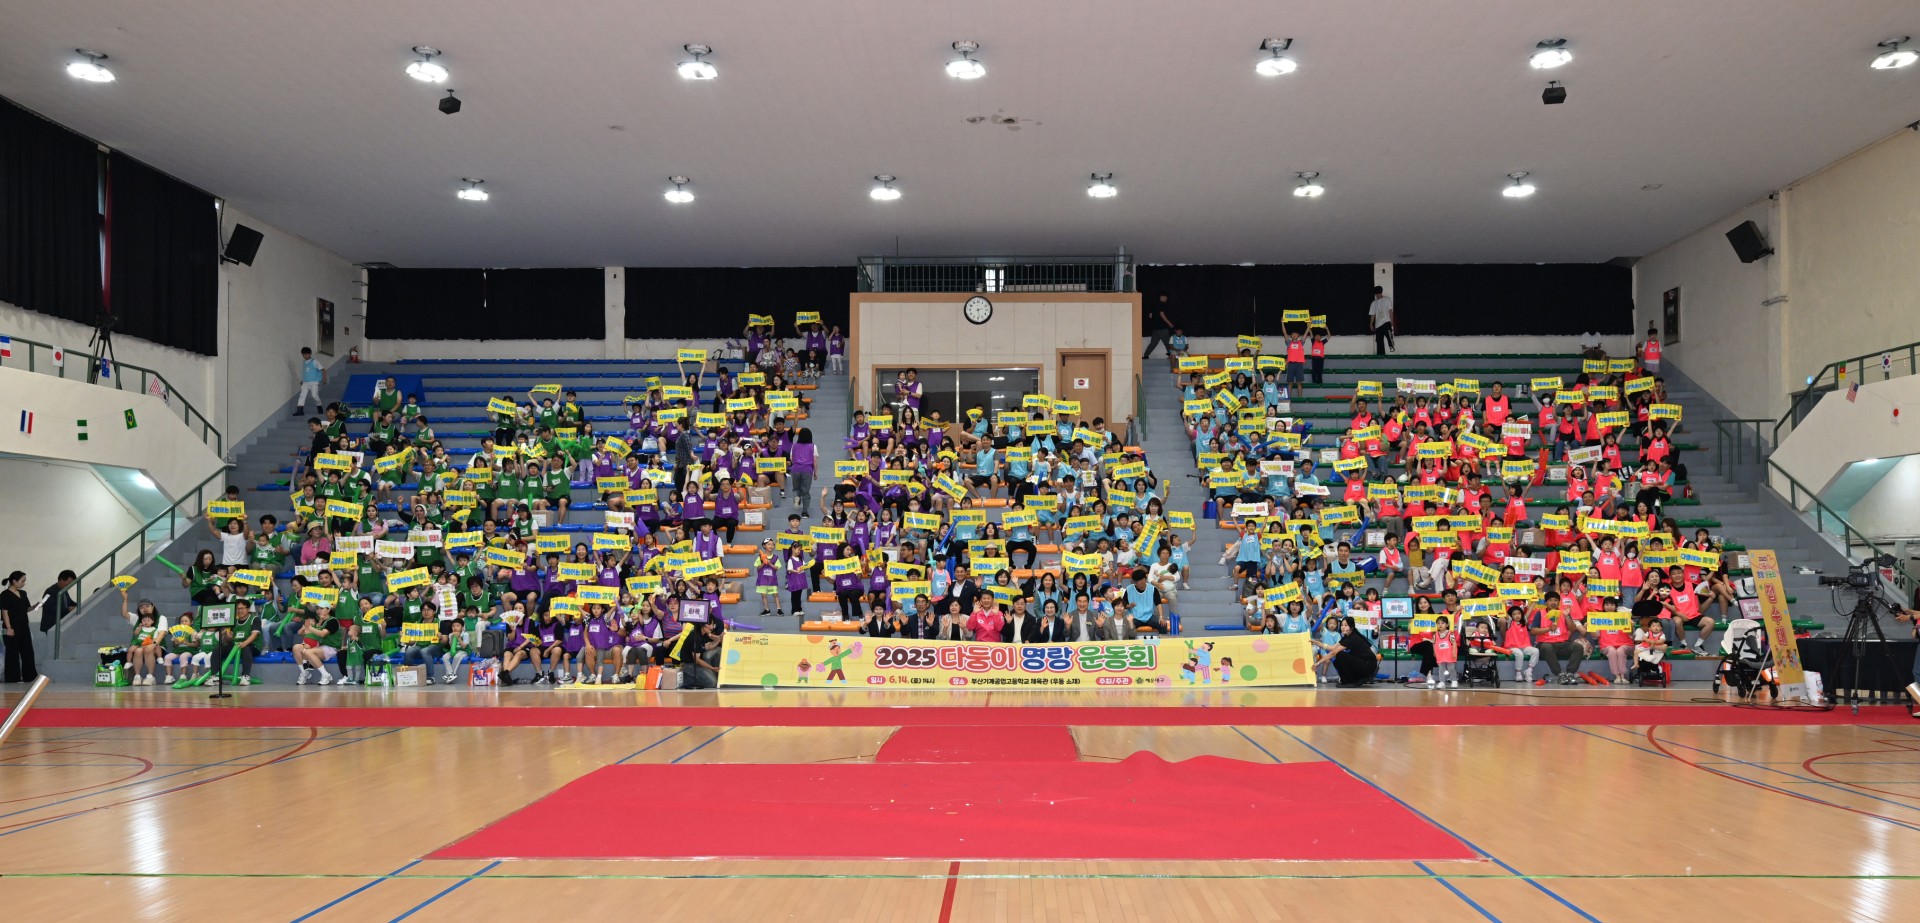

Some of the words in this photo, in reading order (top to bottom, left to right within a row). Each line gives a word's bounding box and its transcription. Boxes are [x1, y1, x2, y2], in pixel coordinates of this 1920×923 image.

[1764, 584, 1787, 646] 접수대
[877, 647, 936, 666] 2025
[940, 646, 1014, 670] 다둥이
[1022, 647, 1074, 670] 명랑
[1078, 646, 1154, 669] 운동회
